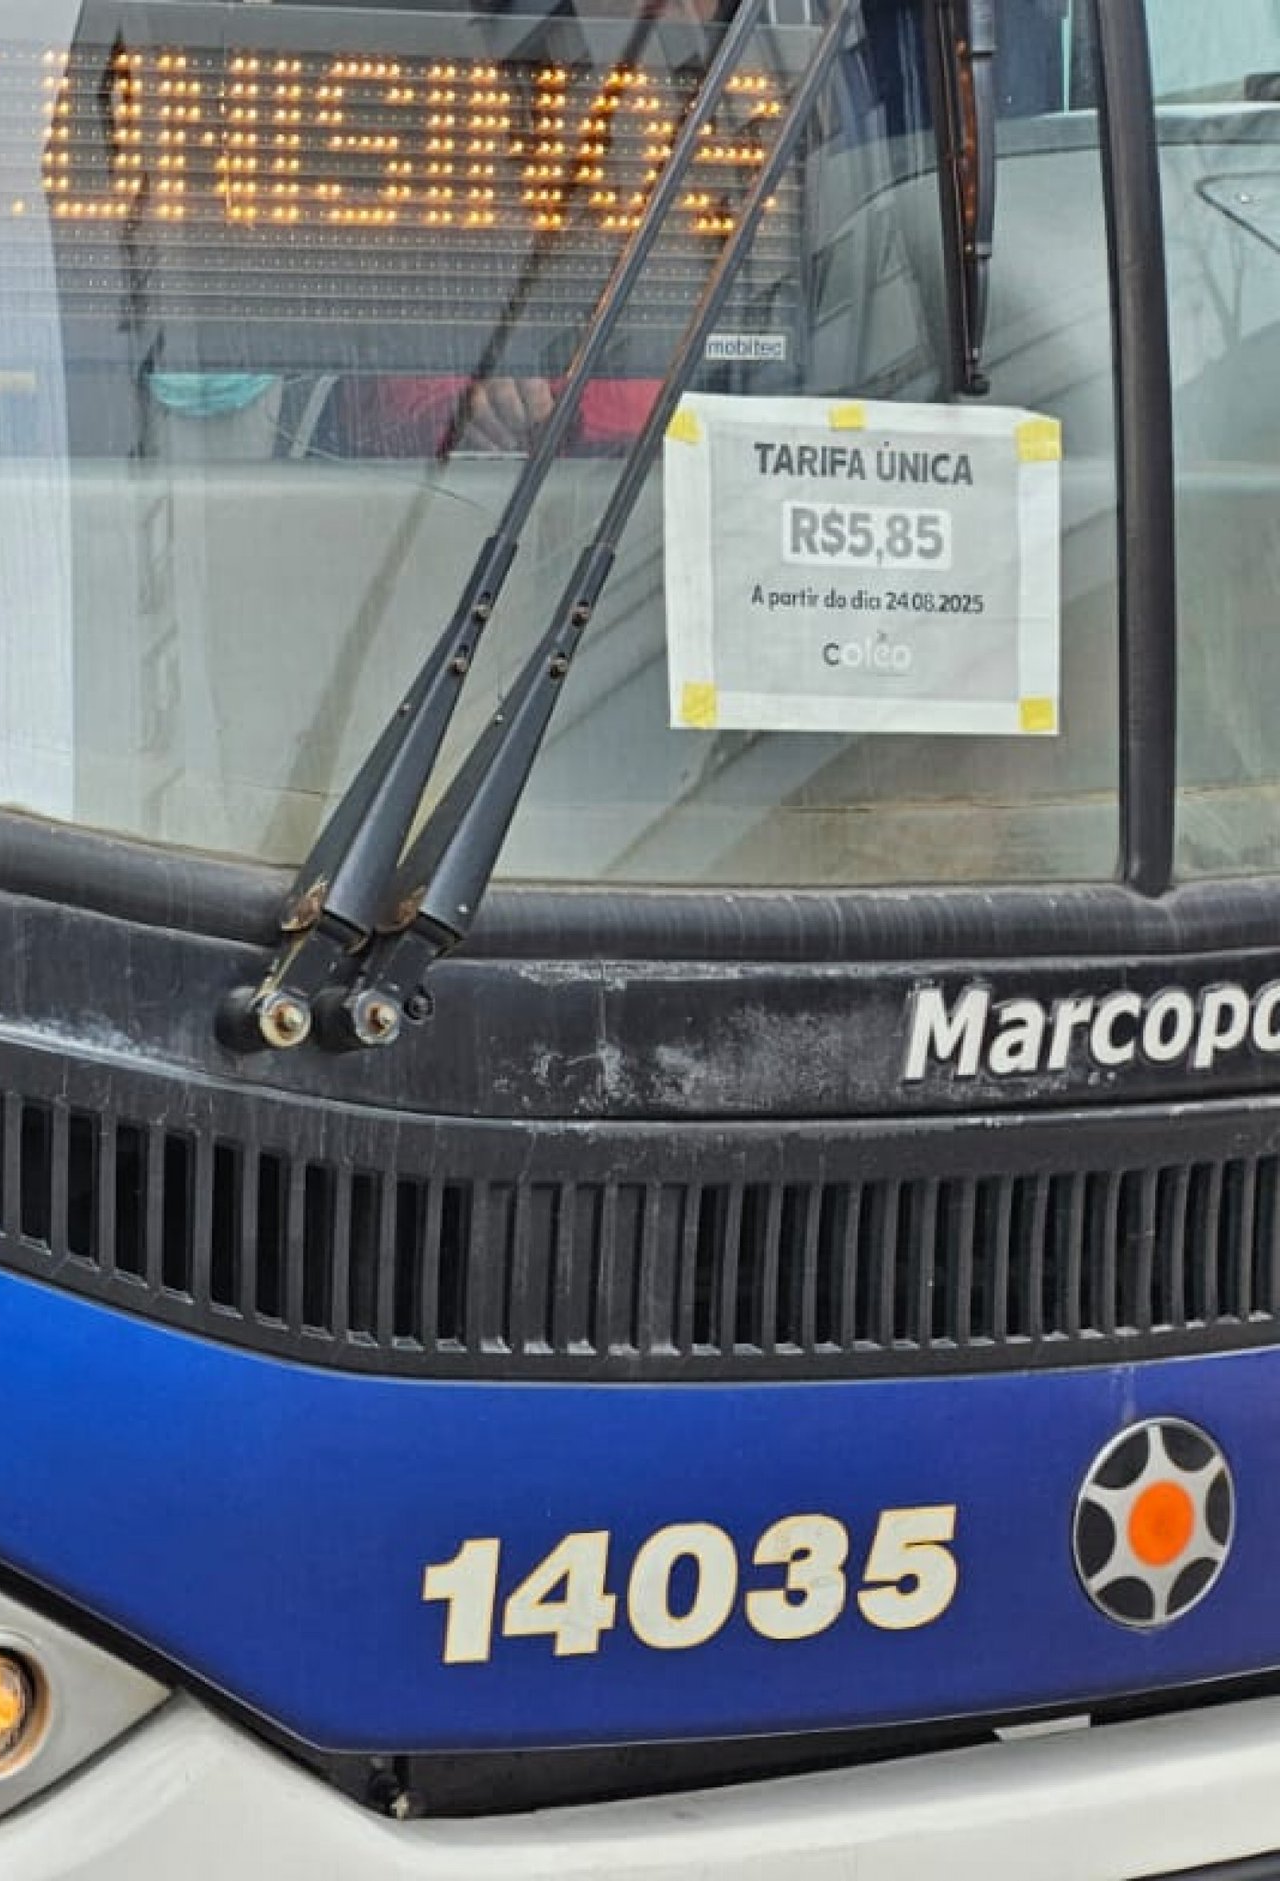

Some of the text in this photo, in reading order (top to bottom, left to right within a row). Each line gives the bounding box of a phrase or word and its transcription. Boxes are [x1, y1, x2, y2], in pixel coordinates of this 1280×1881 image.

[708, 339, 783, 358] mobitec
[753, 441, 974, 486] TARIFA ÚNICA
[790, 507, 944, 566] R$5,85
[751, 584, 764, 605] A
[768, 587, 820, 612] partir
[851, 589, 881, 610] dia
[422, 1504, 958, 1664] 14035
